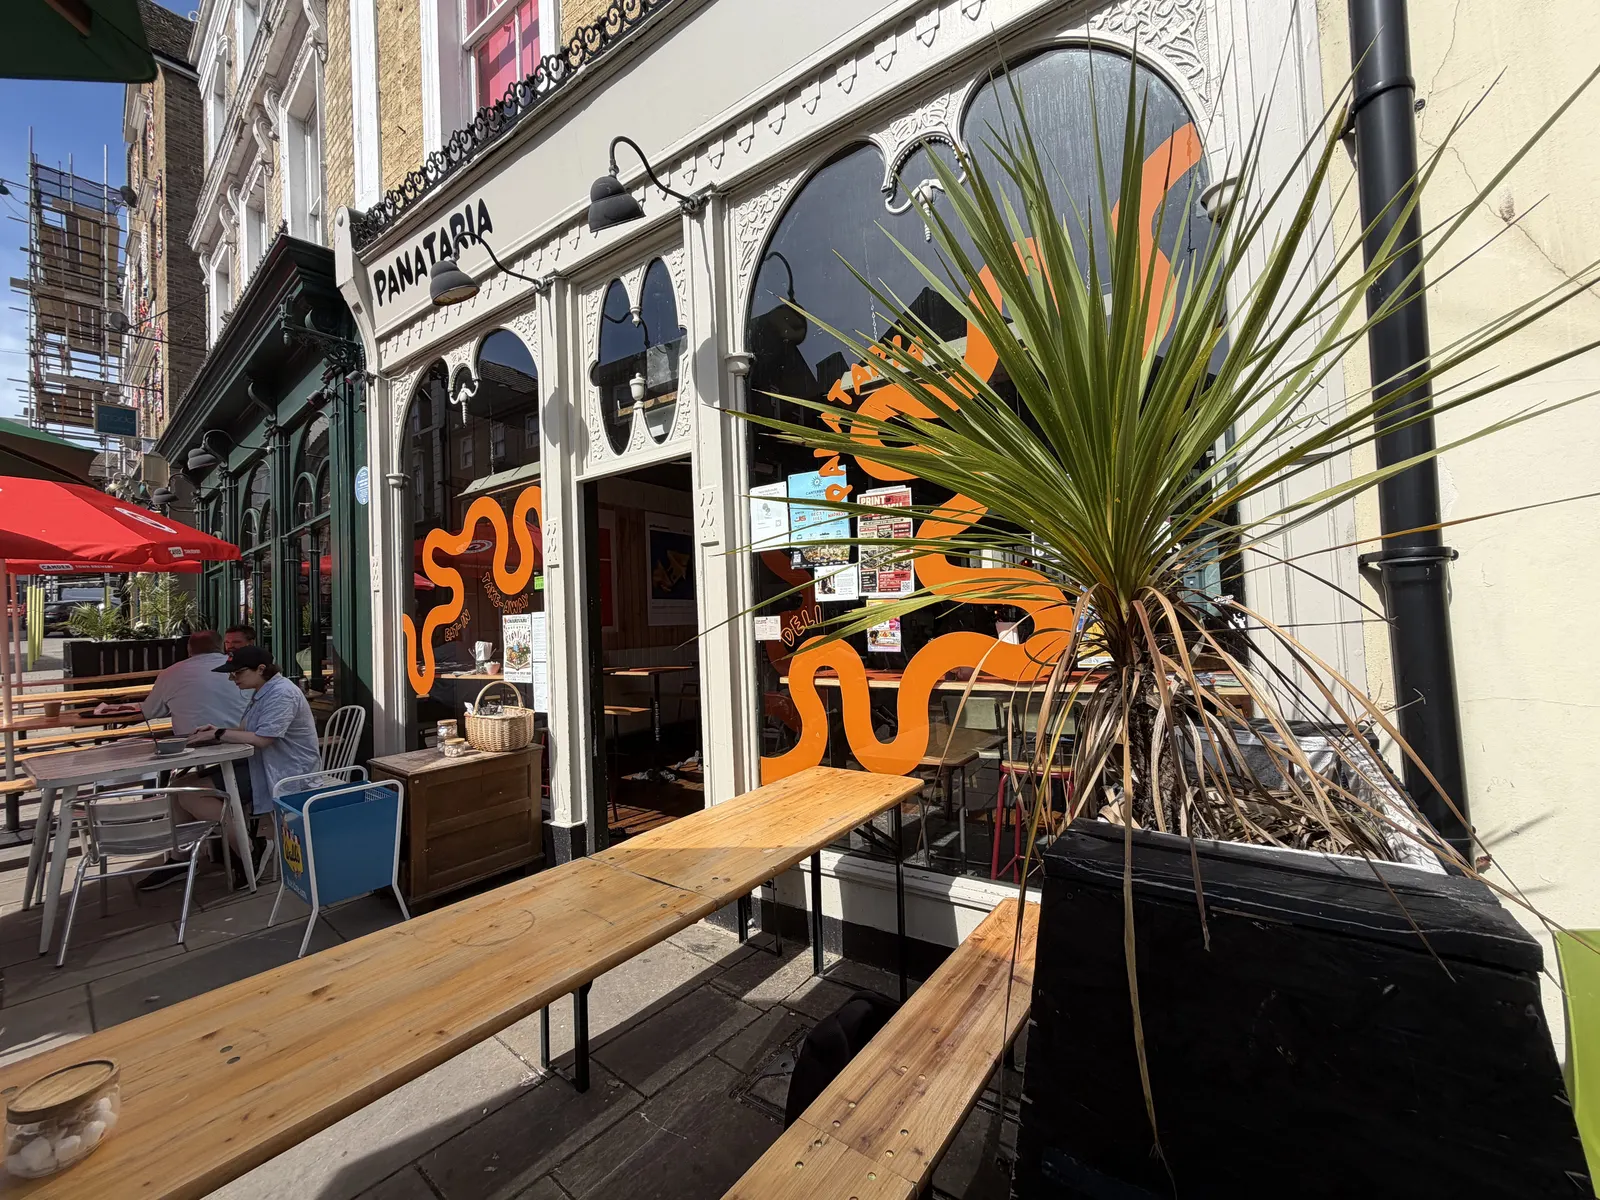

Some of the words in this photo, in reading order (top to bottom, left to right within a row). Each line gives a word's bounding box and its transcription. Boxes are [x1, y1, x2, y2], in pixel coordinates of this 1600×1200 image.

[373, 197, 493, 308] PANATARIA
[860, 495, 886, 506] PRINT
[444, 608, 471, 642] EAT-IN
[780, 604, 822, 647] DELI
